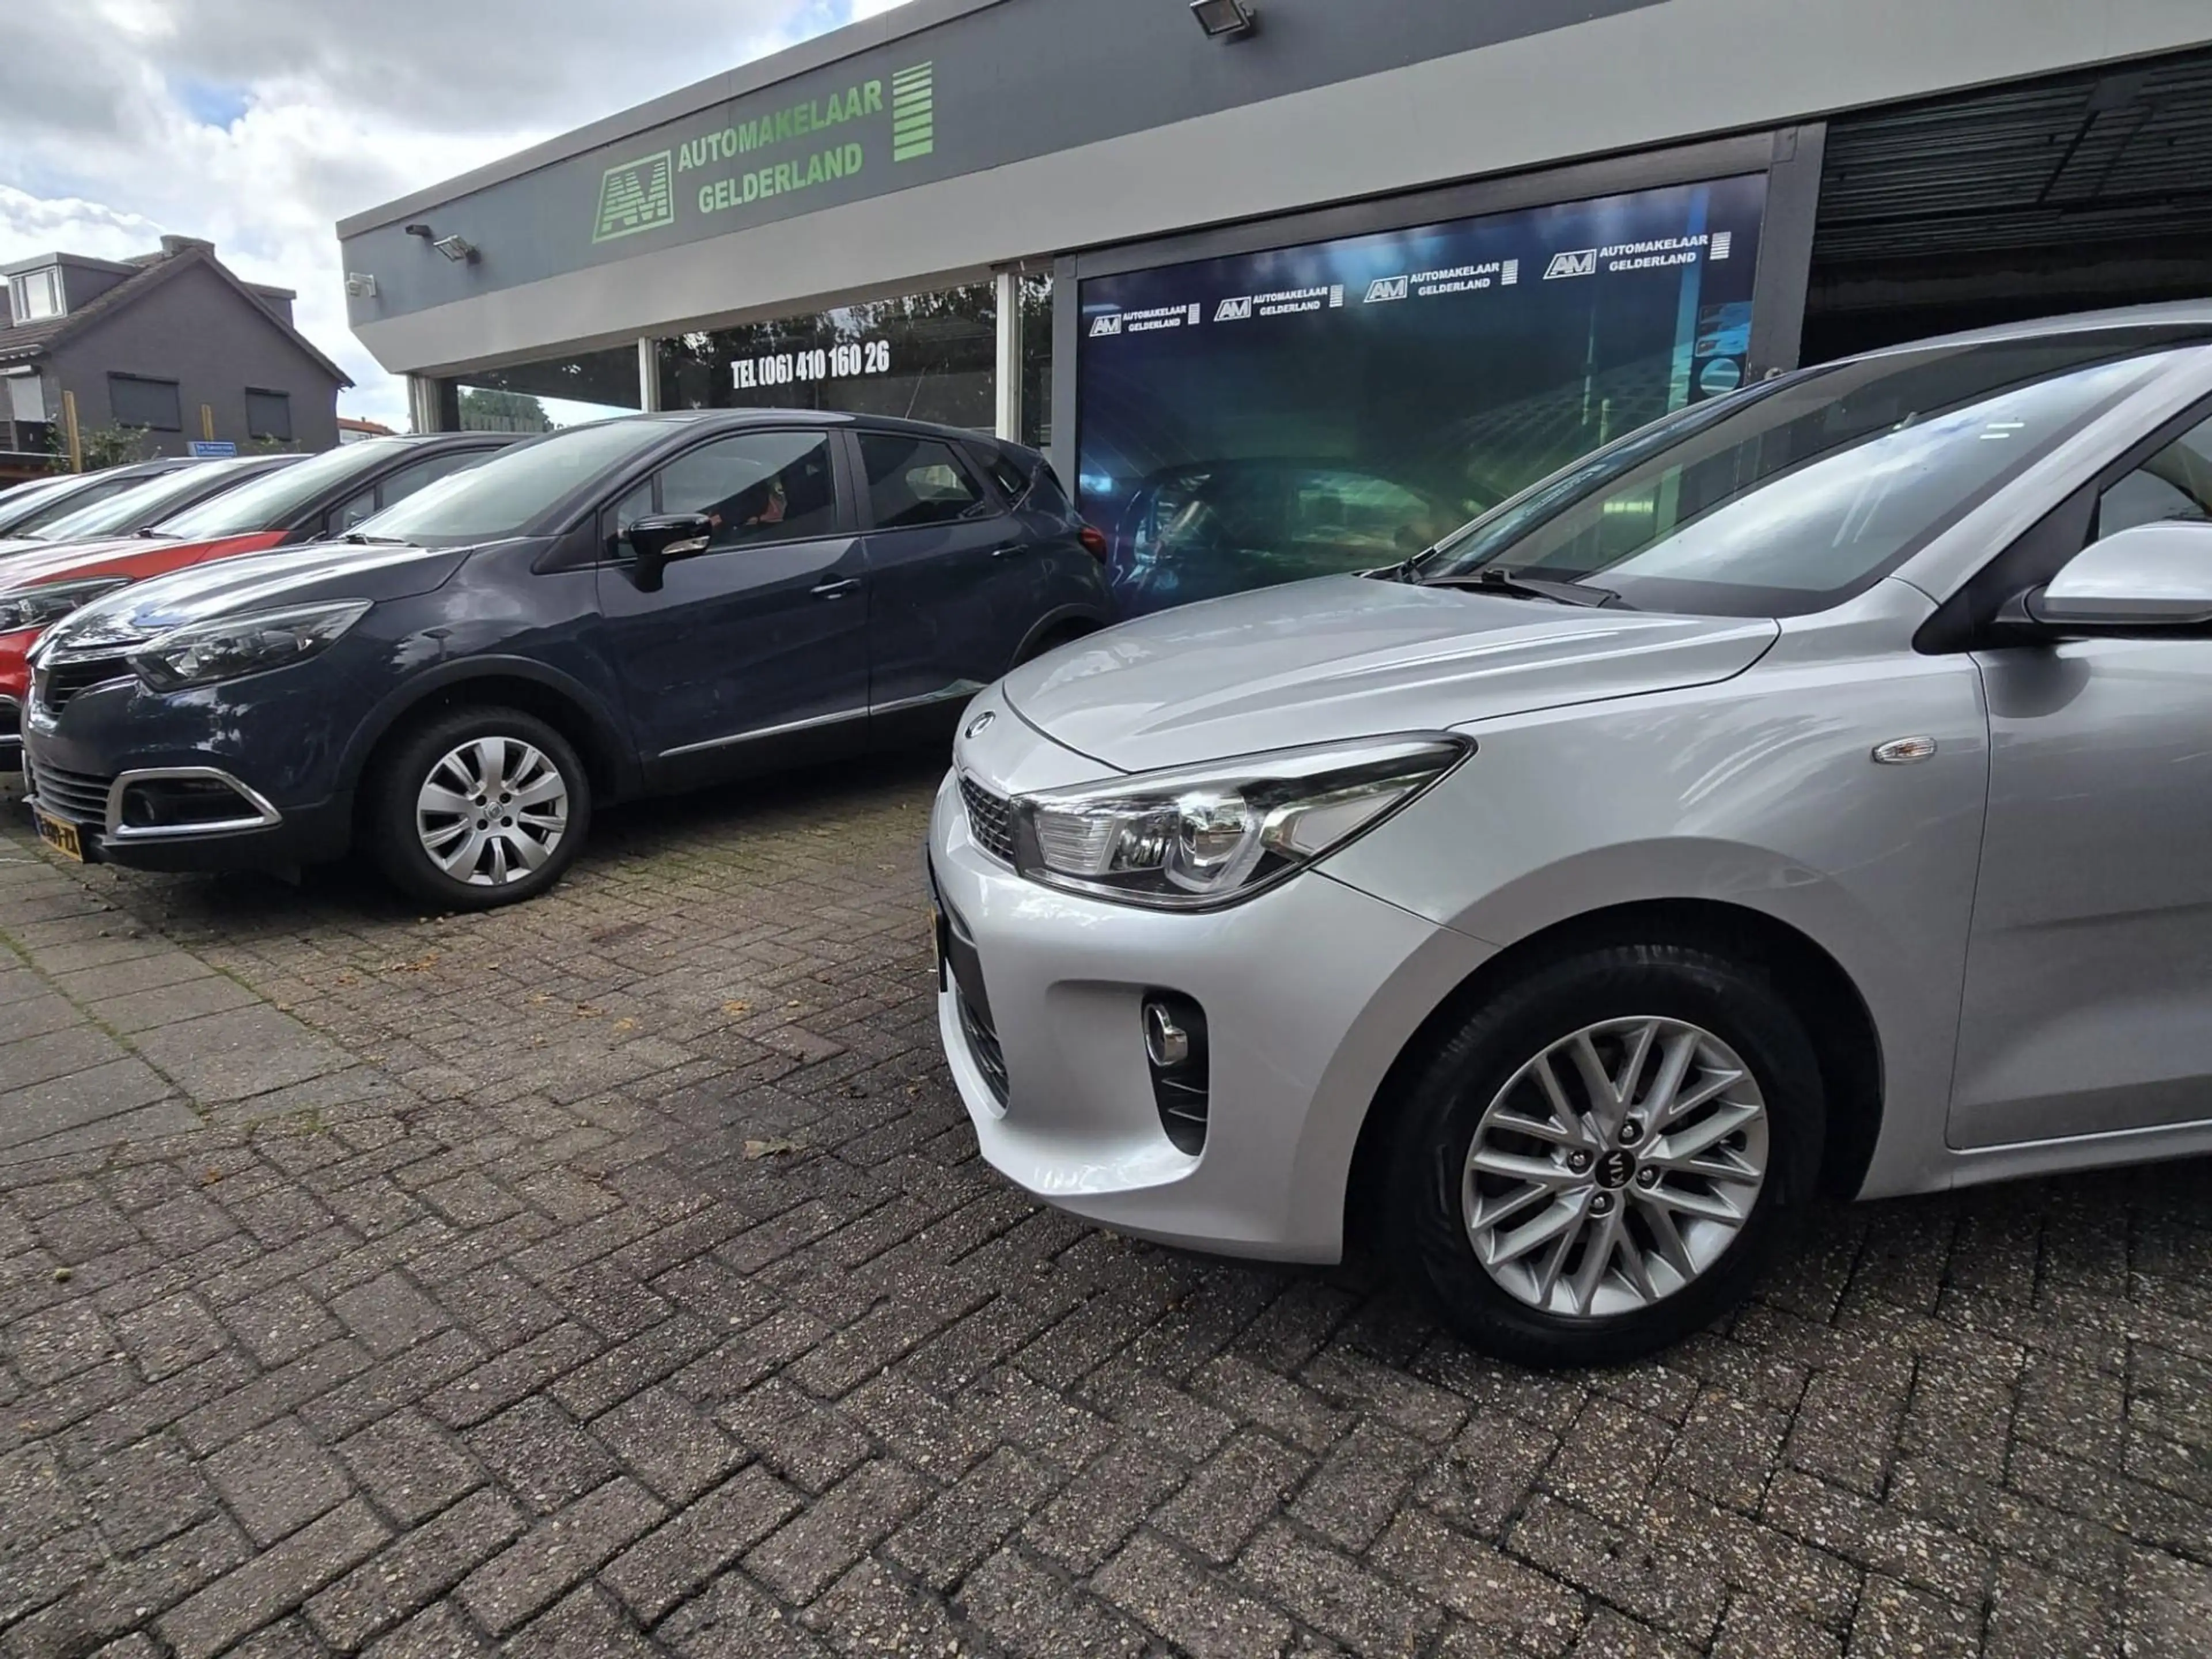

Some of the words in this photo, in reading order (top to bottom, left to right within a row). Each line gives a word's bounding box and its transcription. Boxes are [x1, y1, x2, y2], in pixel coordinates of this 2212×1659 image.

[678, 79, 882, 172] AUTOMAKELAAR
[699, 143, 862, 213] GELDERLAND
[601, 162, 666, 232] AM
[1599, 234, 1708, 257] AUTOMAKELAAR
[1550, 253, 1592, 275] AM
[1609, 252, 1696, 271] GELDERLAND
[1410, 262, 1499, 283] AUTOMAKELAAR
[1253, 287, 1328, 304] AUTOMAKELAAR
[1370, 279, 1404, 299] AM
[1418, 278, 1490, 296] GELDERLAND
[1123, 305, 1186, 321] AUTOMAKELAAR
[1219, 300, 1248, 317] AM
[1260, 301, 1320, 315] GELDERLAND
[1128, 318, 1180, 332] GELDERLAND
[730, 359, 757, 389] TEL
[759, 354, 793, 385] (06)
[796, 349, 825, 381] 410
[829, 343, 861, 377] 160
[865, 340, 889, 373] 26
[1609, 1153, 1624, 1187] KIA
